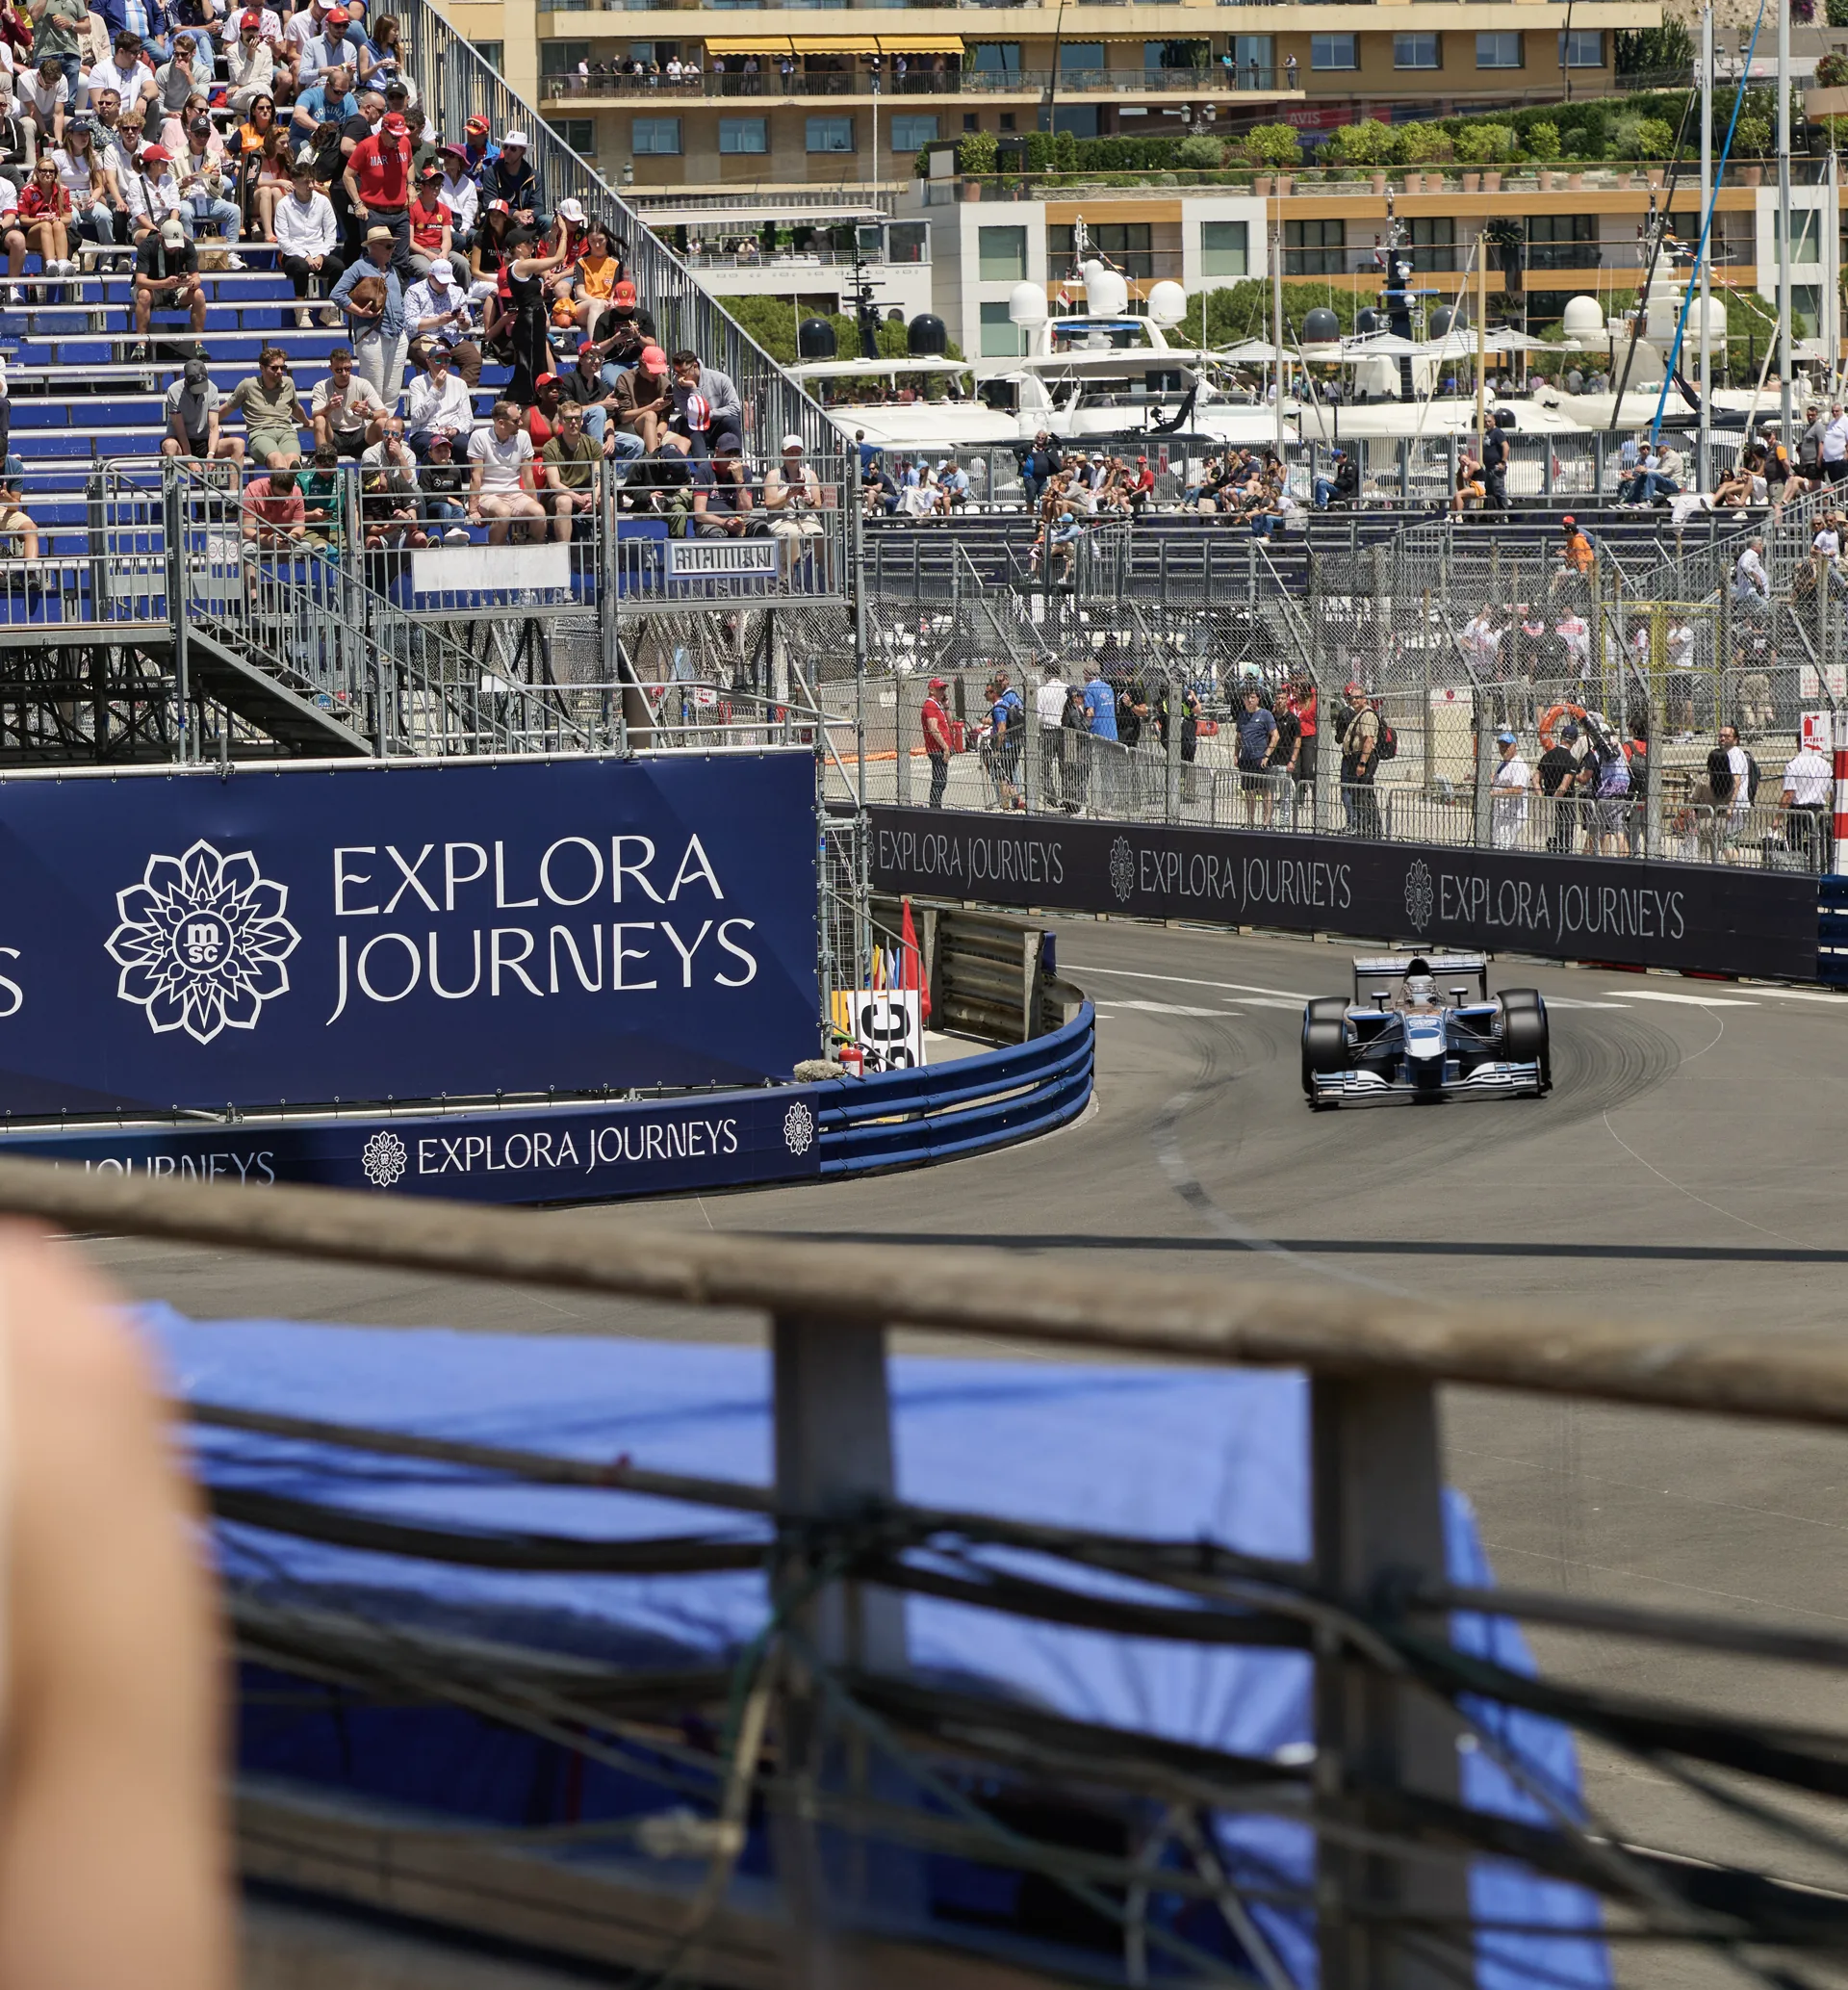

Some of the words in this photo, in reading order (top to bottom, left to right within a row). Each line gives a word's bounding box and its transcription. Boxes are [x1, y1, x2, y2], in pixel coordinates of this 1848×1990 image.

[1290, 111, 1321, 125] AVIS
[334, 833, 724, 916] EXPLORA
[879, 830, 962, 876] EXPLORA
[967, 838, 1064, 891] JOURNEYS
[1140, 850, 1237, 899] EXPLORA
[1241, 858, 1351, 914] JOURNEYS
[1440, 874, 1551, 930] EXPLORA
[1555, 884, 1684, 944] JOURNEYS
[326, 917, 757, 1026] JOURNEYS
[85, 1150, 275, 1187] URNEYS
[418, 1130, 578, 1175] EXPLORA
[585, 1118, 738, 1175] JOURNEYS
